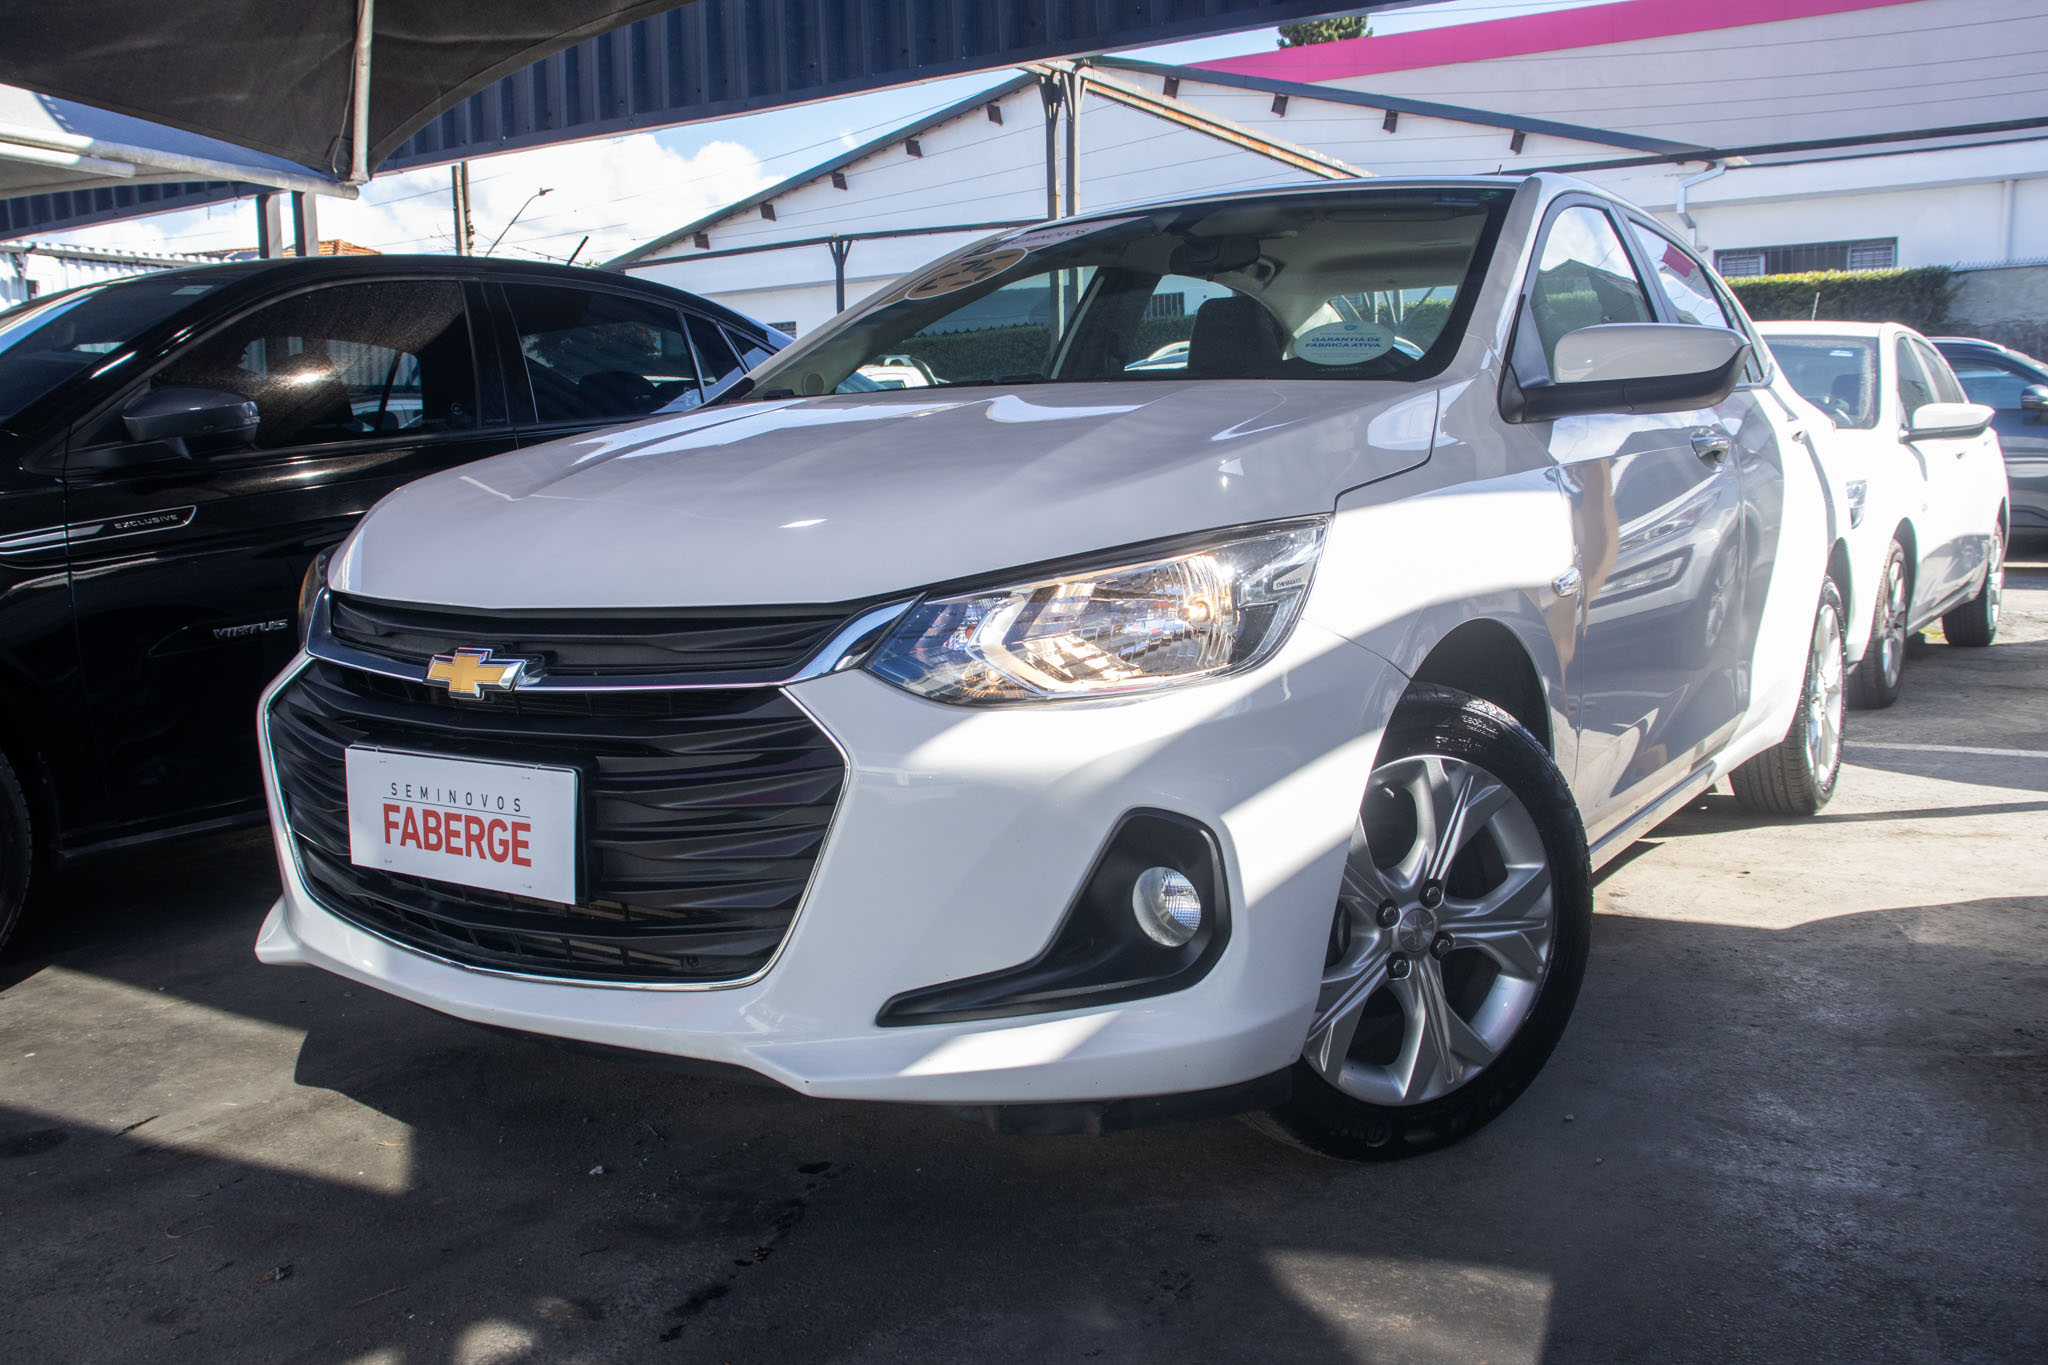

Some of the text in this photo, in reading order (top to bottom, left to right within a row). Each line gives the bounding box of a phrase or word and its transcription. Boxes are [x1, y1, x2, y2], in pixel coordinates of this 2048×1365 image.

[113, 514, 180, 530] EXCLUSIVE
[212, 618, 288, 639] VIRTUS
[391, 782, 521, 812] SEMINOVOS
[383, 803, 532, 868] FABERGE
